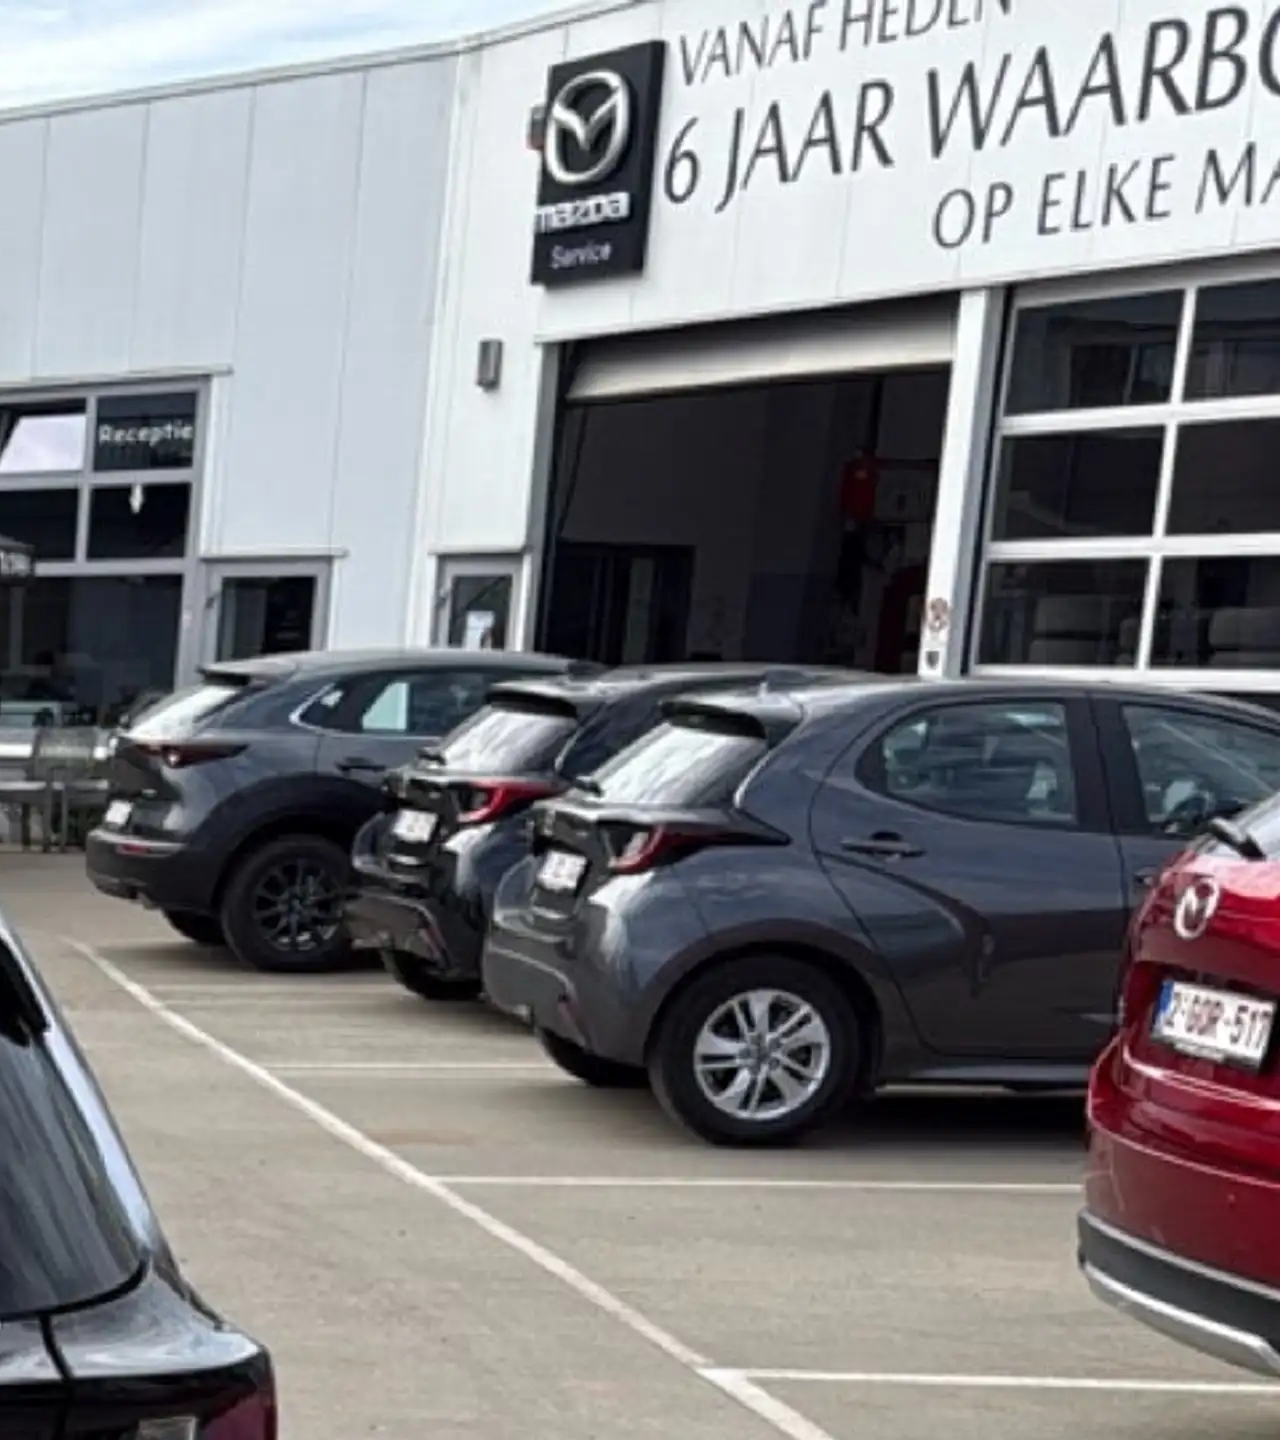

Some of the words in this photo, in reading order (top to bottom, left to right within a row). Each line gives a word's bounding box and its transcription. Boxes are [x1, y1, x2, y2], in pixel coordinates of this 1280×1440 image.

[680, 0, 827, 86] VANAF
[839, 0, 1011, 51] HED
[663, 115, 701, 204] 6
[714, 78, 895, 214] JAAR
[931, 181, 1014, 250] OP
[1035, 153, 1176, 236] ELKE
[550, 240, 612, 269] Service
[98, 418, 193, 448] Receptie
